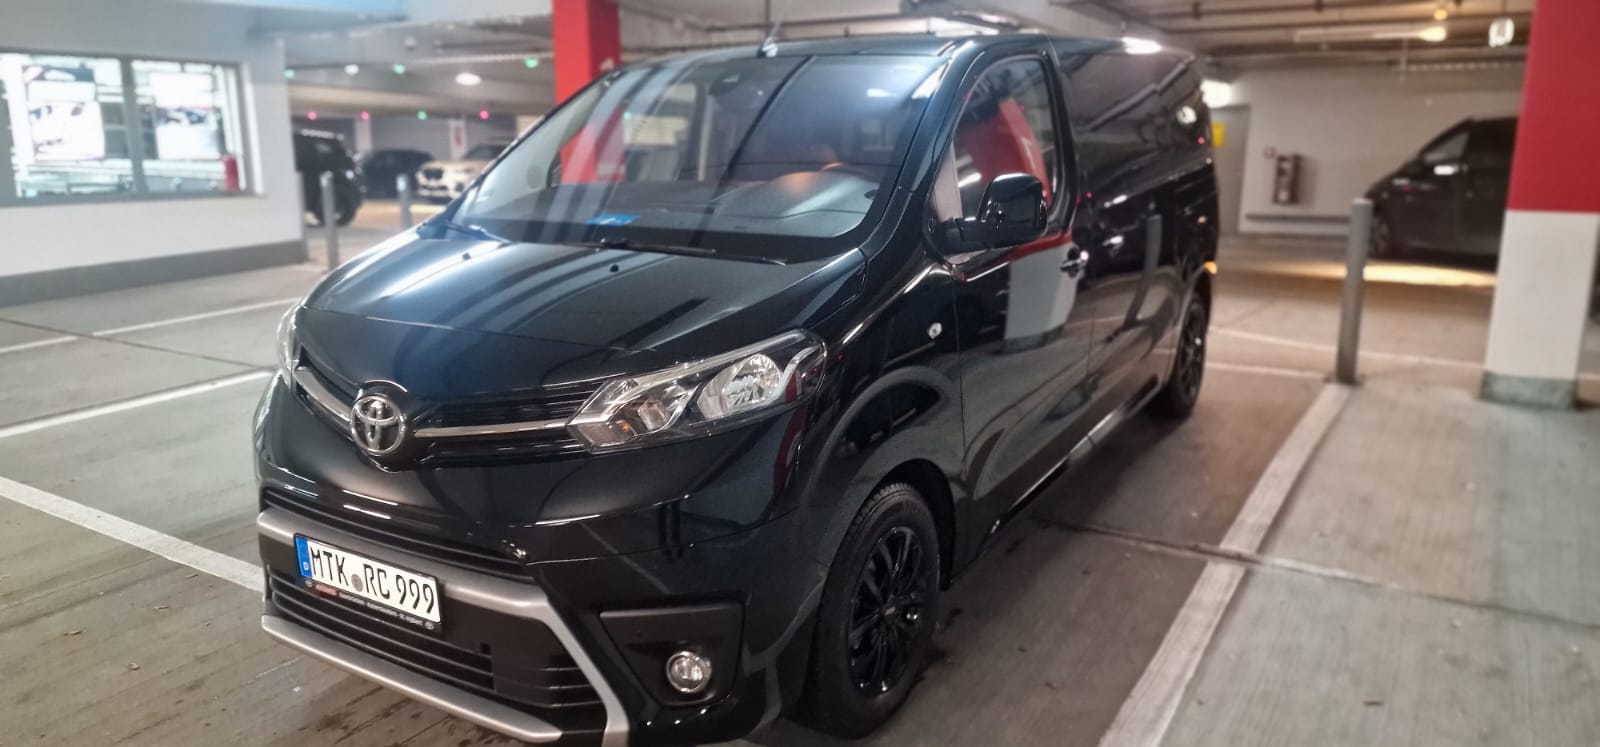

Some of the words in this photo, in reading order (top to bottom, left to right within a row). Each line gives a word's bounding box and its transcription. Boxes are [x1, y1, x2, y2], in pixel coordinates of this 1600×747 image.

[310, 547, 349, 586] MTK
[363, 563, 391, 599] RC
[395, 574, 435, 613] 999
